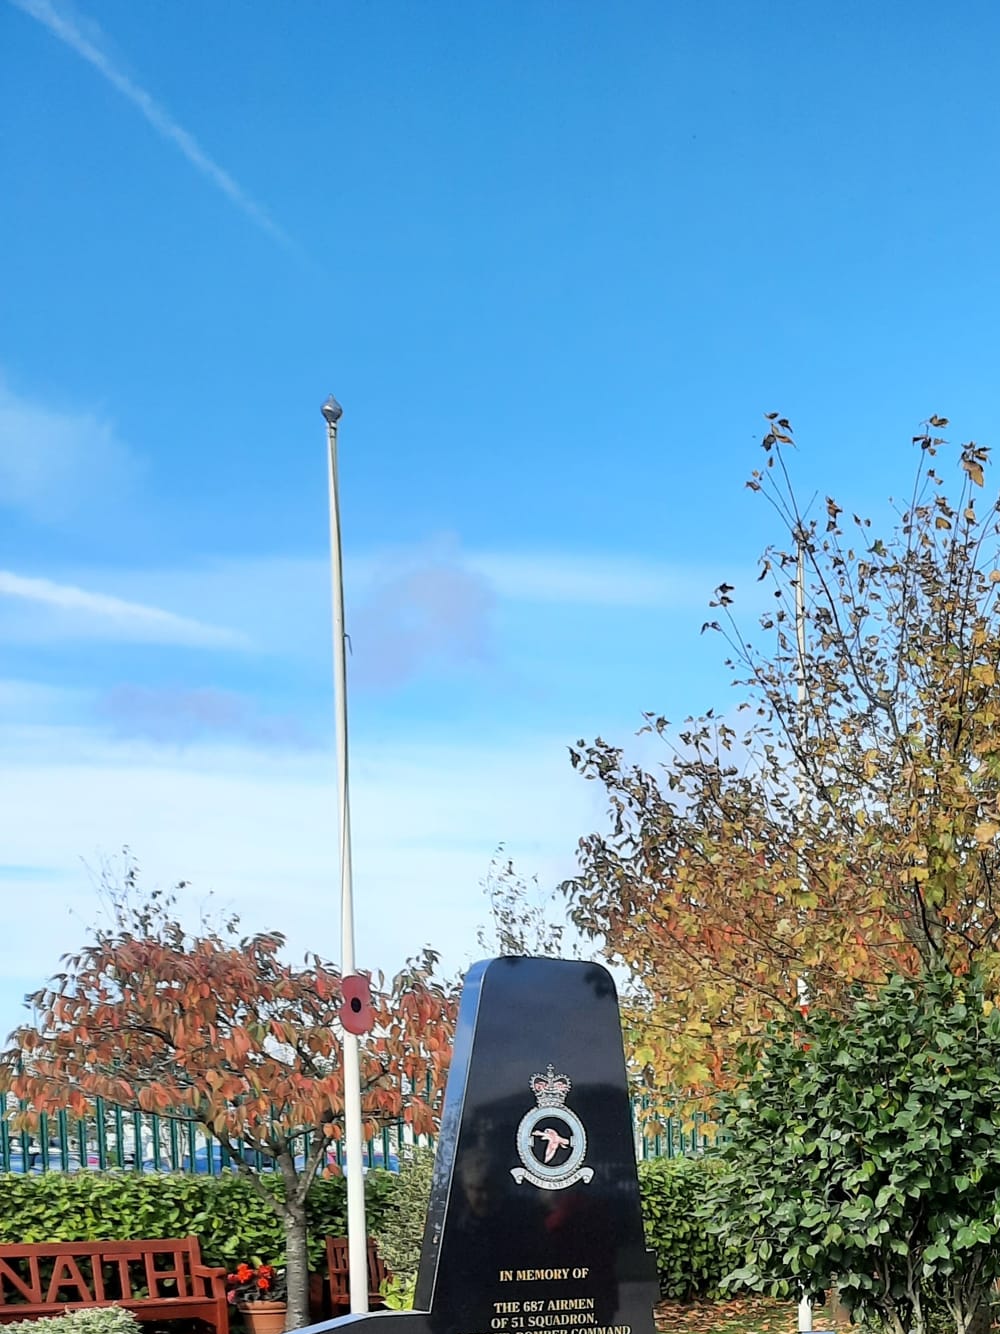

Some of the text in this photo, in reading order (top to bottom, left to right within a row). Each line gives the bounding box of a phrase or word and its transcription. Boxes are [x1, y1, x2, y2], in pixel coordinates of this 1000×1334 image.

[500, 1268, 589, 1281] IN MEMORY OF
[494, 1299, 594, 1313] THE 687 AIRMEN
[491, 1318, 509, 1328] OF
[512, 1317, 524, 1327] 51
